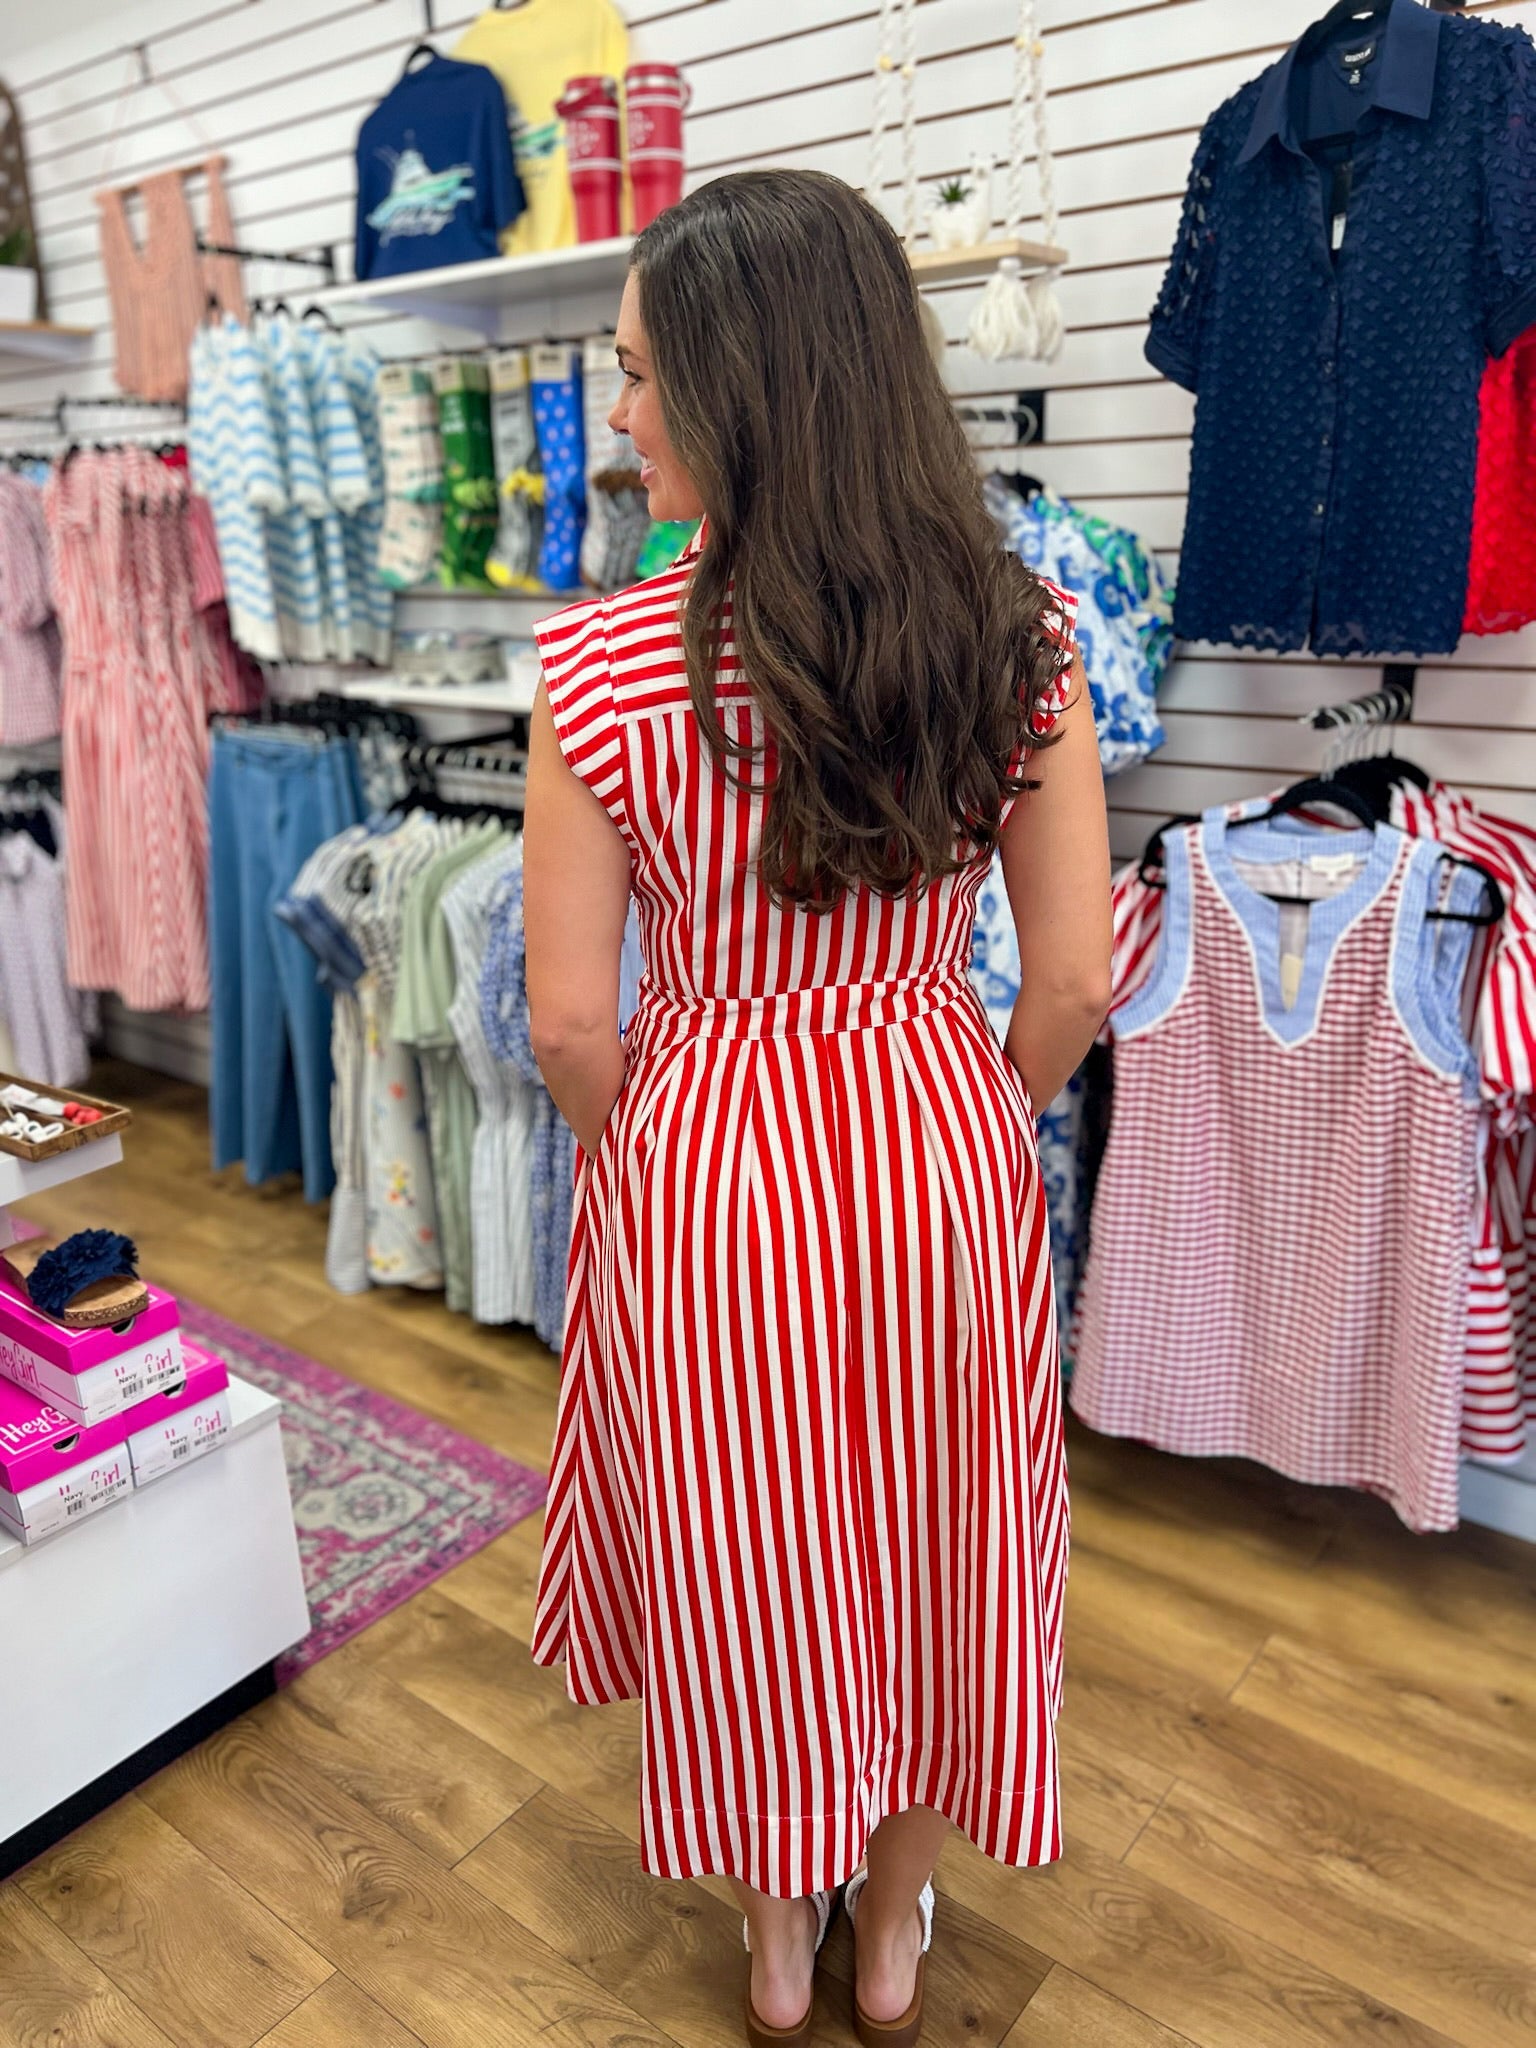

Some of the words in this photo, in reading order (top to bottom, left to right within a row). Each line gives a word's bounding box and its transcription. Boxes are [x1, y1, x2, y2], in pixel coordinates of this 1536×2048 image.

[0, 1343, 41, 1389] eyGirl
[119, 1373, 137, 1384] Navy
[170, 1435, 188, 1446] Navy
[64, 1489, 84, 1503] Navy
